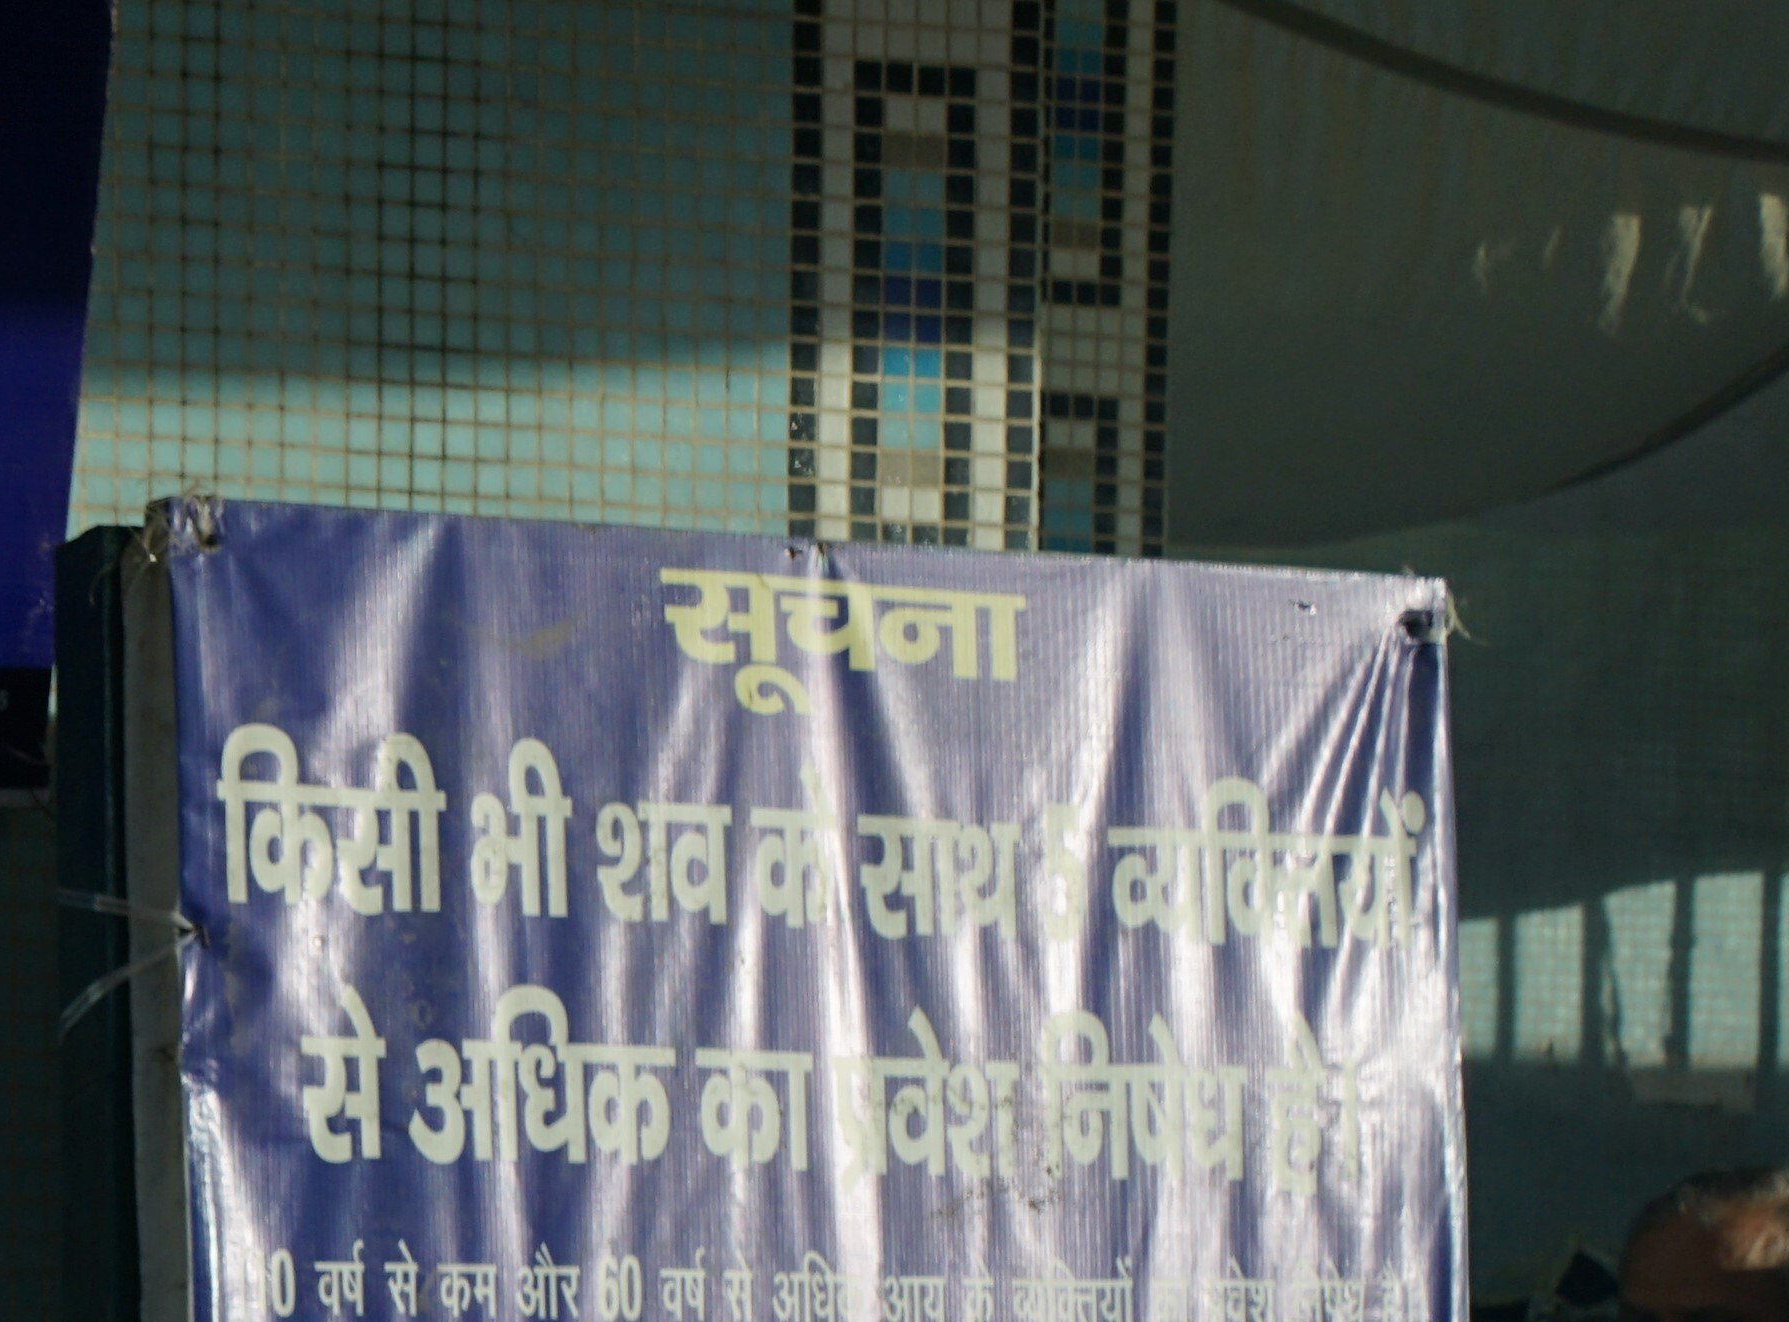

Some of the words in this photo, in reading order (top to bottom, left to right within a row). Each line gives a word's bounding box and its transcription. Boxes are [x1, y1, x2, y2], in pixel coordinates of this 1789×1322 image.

[660, 567, 1026, 715] सूचना
[217, 723, 446, 916] किसी
[470, 737, 572, 918] भी
[596, 801, 731, 924] शव
[857, 813, 1022, 941] साथ
[1108, 775, 1427, 949] व्यक्तियों
[300, 984, 387, 1164] से
[409, 984, 677, 1166] अधिक
[696, 1046, 814, 1173] का
[831, 1006, 1019, 1195] प्रवेश
[1038, 1009, 1248, 1181] निषेध
[314, 1238, 366, 1317] वर्ष
[384, 1238, 419, 1317] से
[437, 1262, 497, 1318] कम
[516, 1241, 581, 1320] और
[598, 1253, 642, 1322] 60
[659, 1245, 706, 1322] वर्ष
[722, 1245, 754, 1322] से
